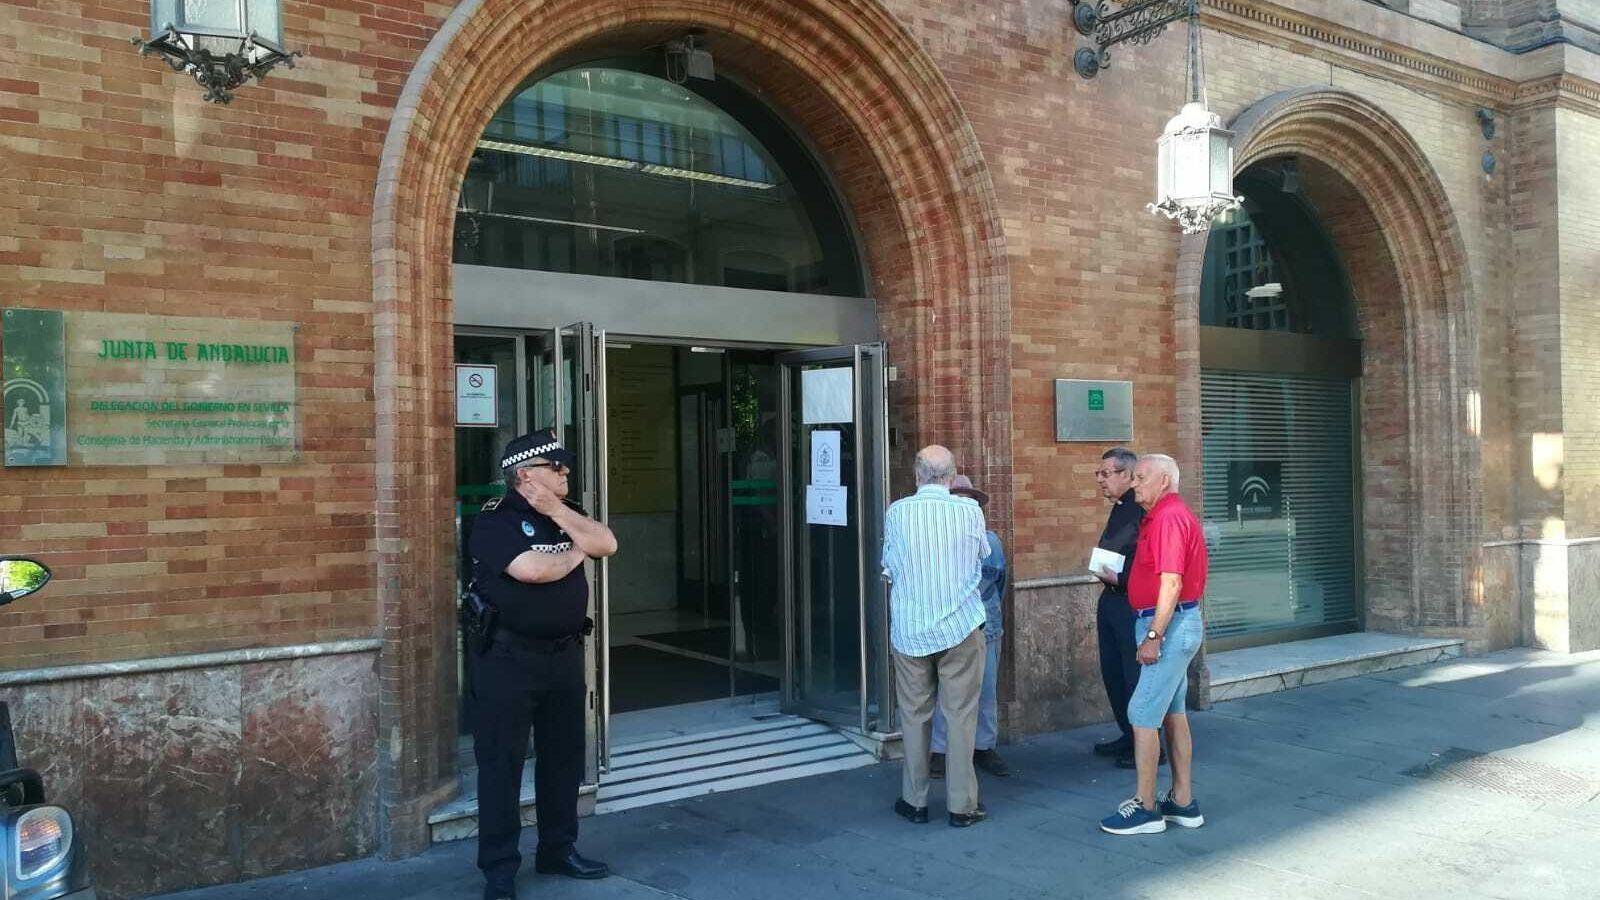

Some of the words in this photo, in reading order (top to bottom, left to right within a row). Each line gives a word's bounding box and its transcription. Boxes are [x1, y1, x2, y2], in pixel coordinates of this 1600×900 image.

[98, 340, 156, 359] JUNTA
[166, 342, 187, 361] DE
[161, 401, 180, 412] DEL
[184, 401, 235, 413] GOBIERNO
[238, 402, 251, 413] EN
[254, 402, 289, 413] SEVILLA
[129, 436, 141, 446] de
